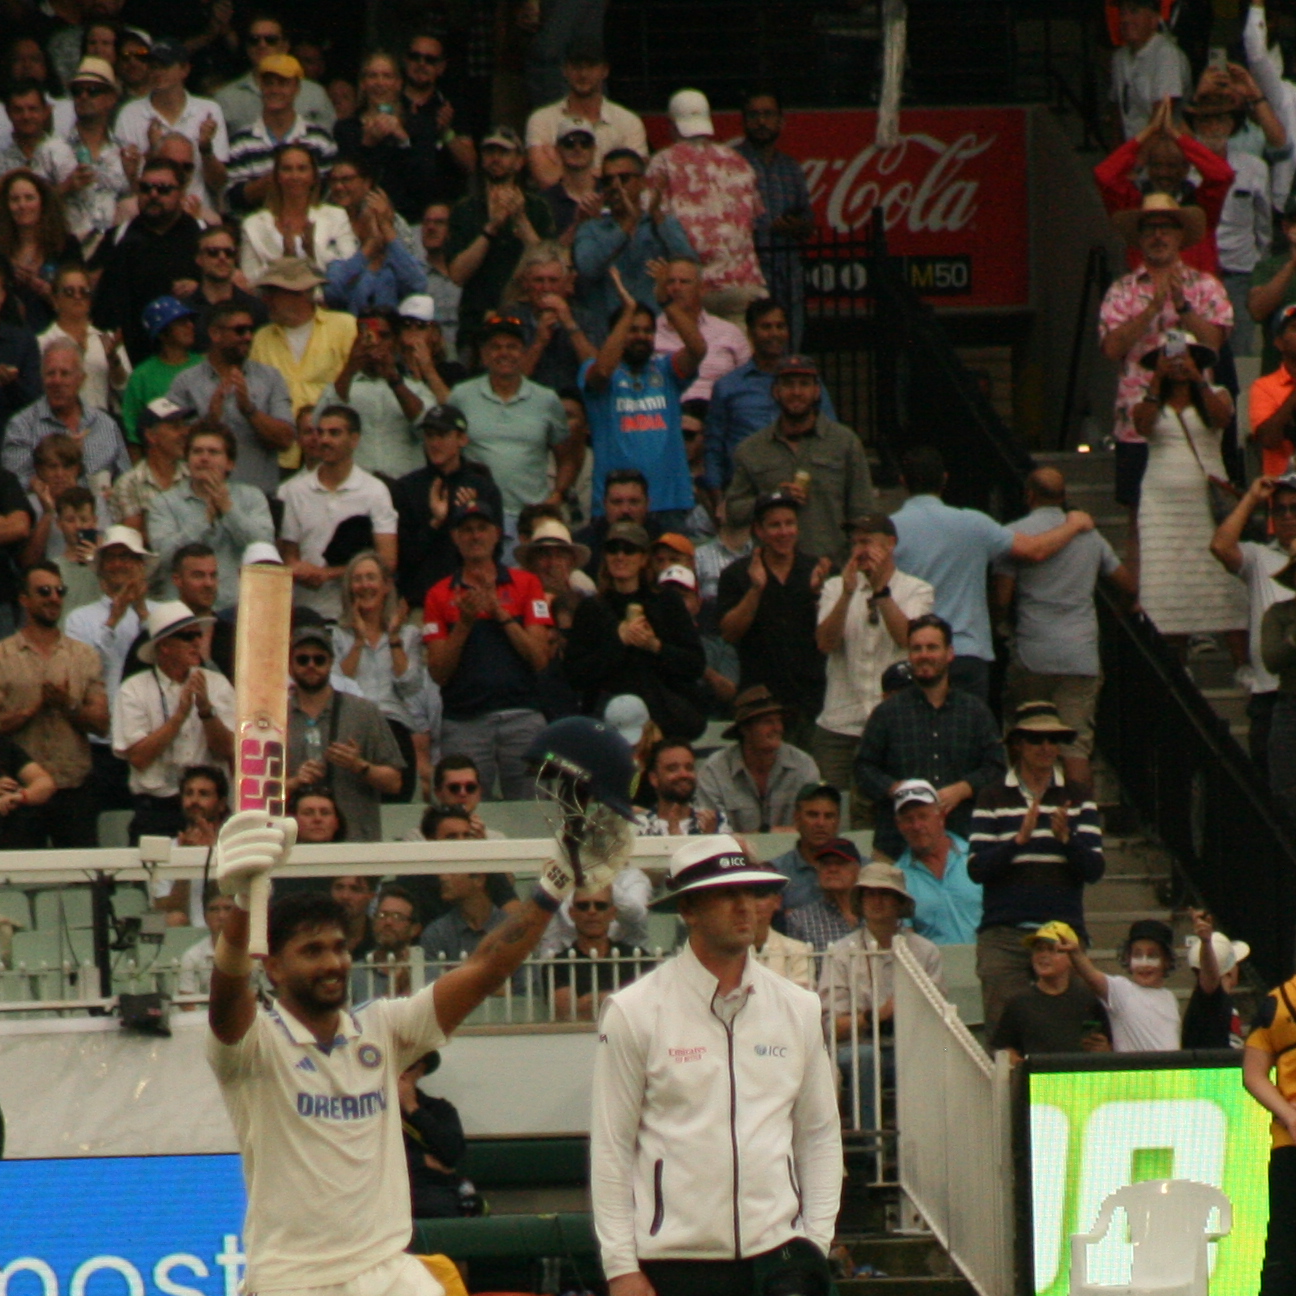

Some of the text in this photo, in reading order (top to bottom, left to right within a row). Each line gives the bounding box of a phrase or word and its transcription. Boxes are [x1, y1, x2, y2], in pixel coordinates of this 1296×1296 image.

[911, 263, 968, 288] M50
[730, 856, 745, 867] ICC
[768, 1045, 788, 1058] ICC
